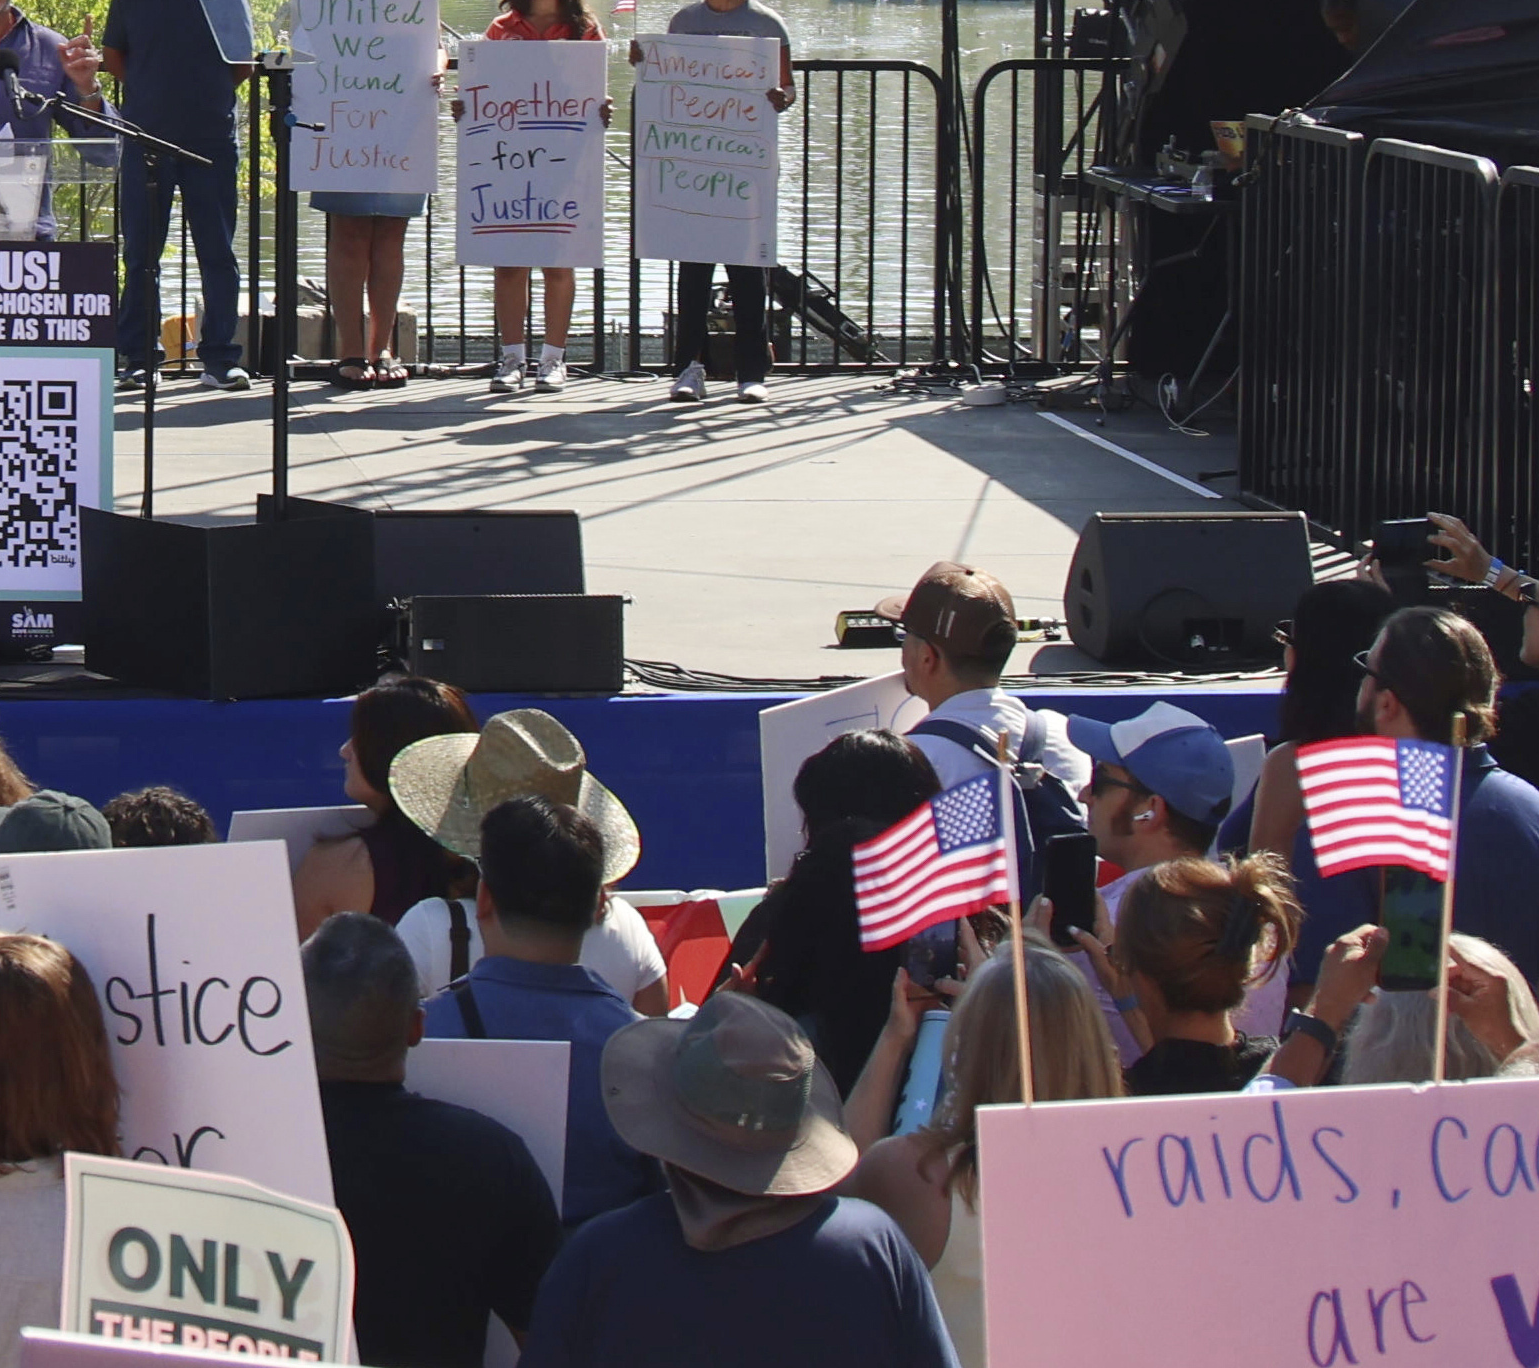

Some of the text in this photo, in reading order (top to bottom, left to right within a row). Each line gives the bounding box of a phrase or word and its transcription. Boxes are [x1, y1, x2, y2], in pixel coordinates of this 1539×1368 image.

[316, 60, 404, 95] Stand
[642, 47, 767, 80] America's
[332, 101, 388, 130] For
[465, 81, 598, 132] Together
[310, 137, 411, 172] Justice
[643, 125, 767, 160] America's
[471, 182, 580, 224] Justice
[73, 294, 111, 316] FOR
[12, 318, 38, 341] AS
[45, 319, 90, 341] THIS
[50, 554, 76, 567] bitly
[12, 614, 54, 628] SAM
[105, 913, 293, 1056] stice
[1102, 1101, 1401, 1217] raids,
[108, 1226, 314, 1322] ONLY
[94, 1311, 320, 1364] THE PEOPLE
[1306, 1280, 1435, 1368] are
